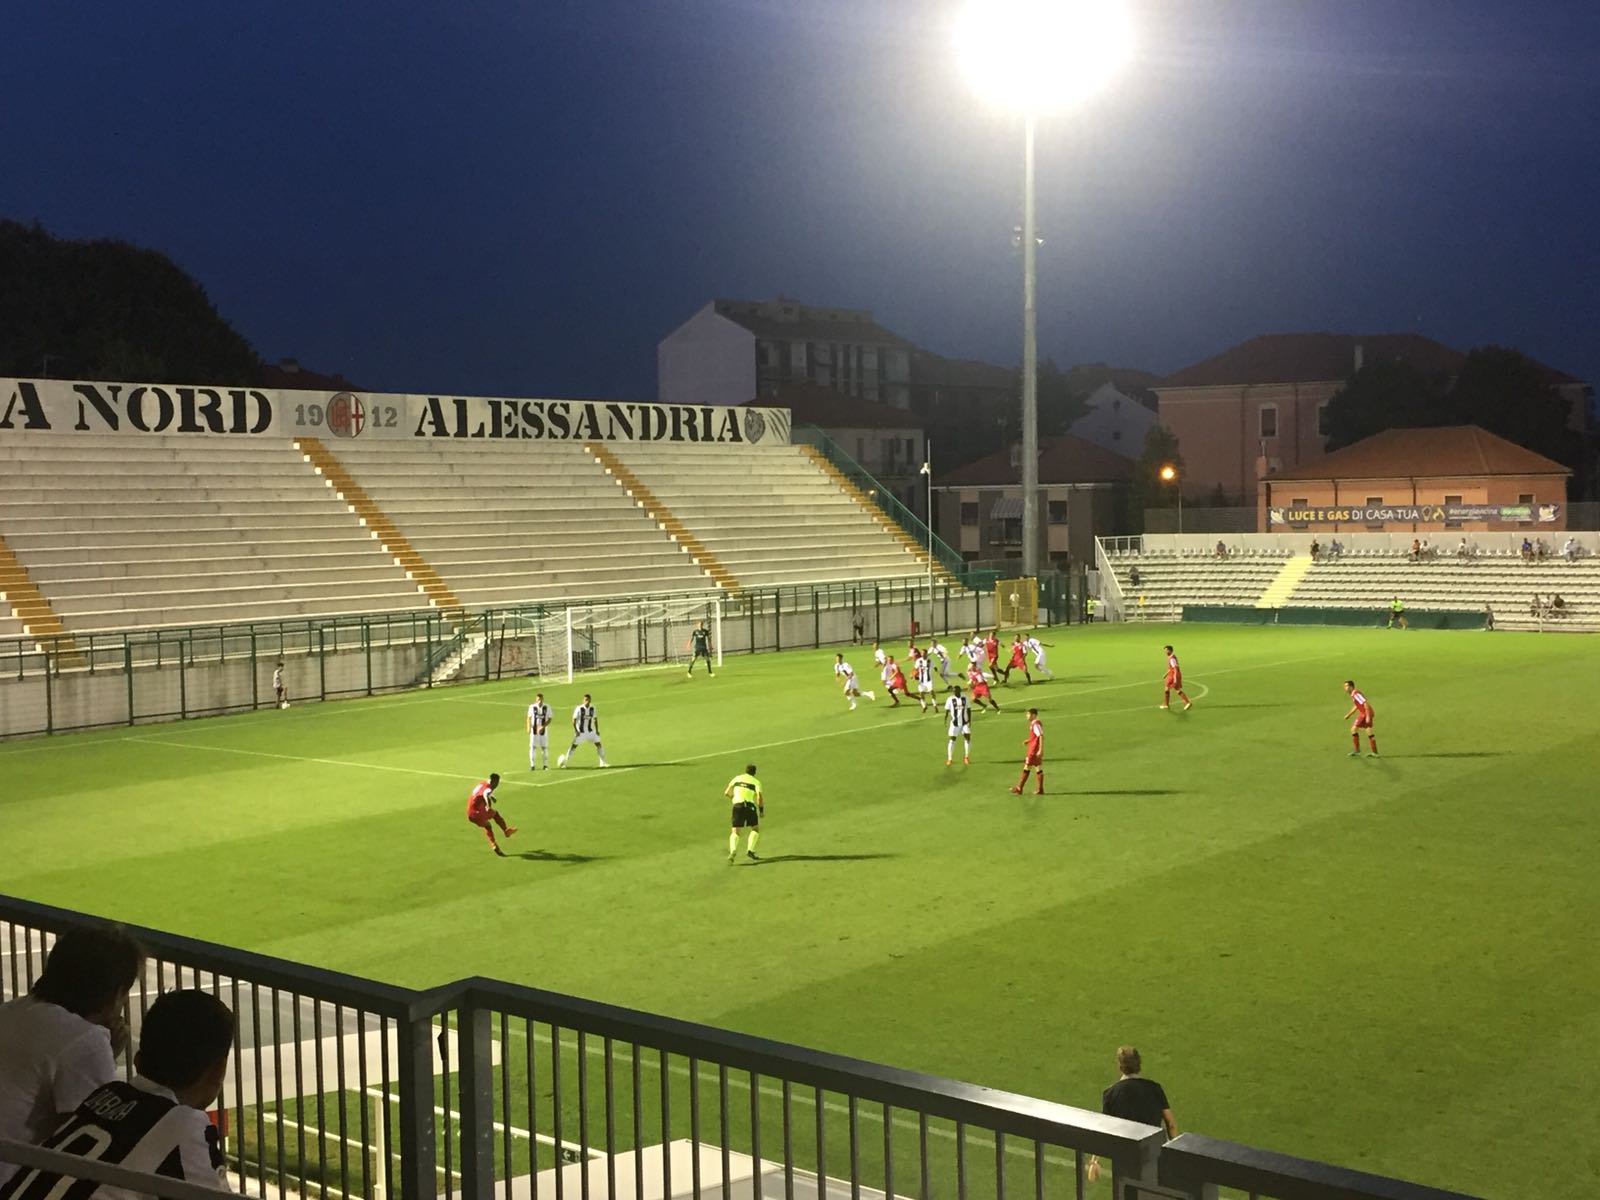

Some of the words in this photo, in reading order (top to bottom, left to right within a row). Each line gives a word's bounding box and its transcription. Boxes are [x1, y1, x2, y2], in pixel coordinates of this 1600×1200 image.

[73, 384, 272, 434] NORD
[295, 404, 324, 426] 19
[371, 406, 398, 428] 12
[414, 397, 743, 442] ALESSANDRIA
[1288, 511, 1316, 521] LUCE
[1318, 511, 1324, 521] E
[1327, 510, 1349, 520] GAS
[1352, 509, 1363, 520] DI
[1366, 509, 1394, 520] CASA
[1397, 509, 1419, 519] TUA
